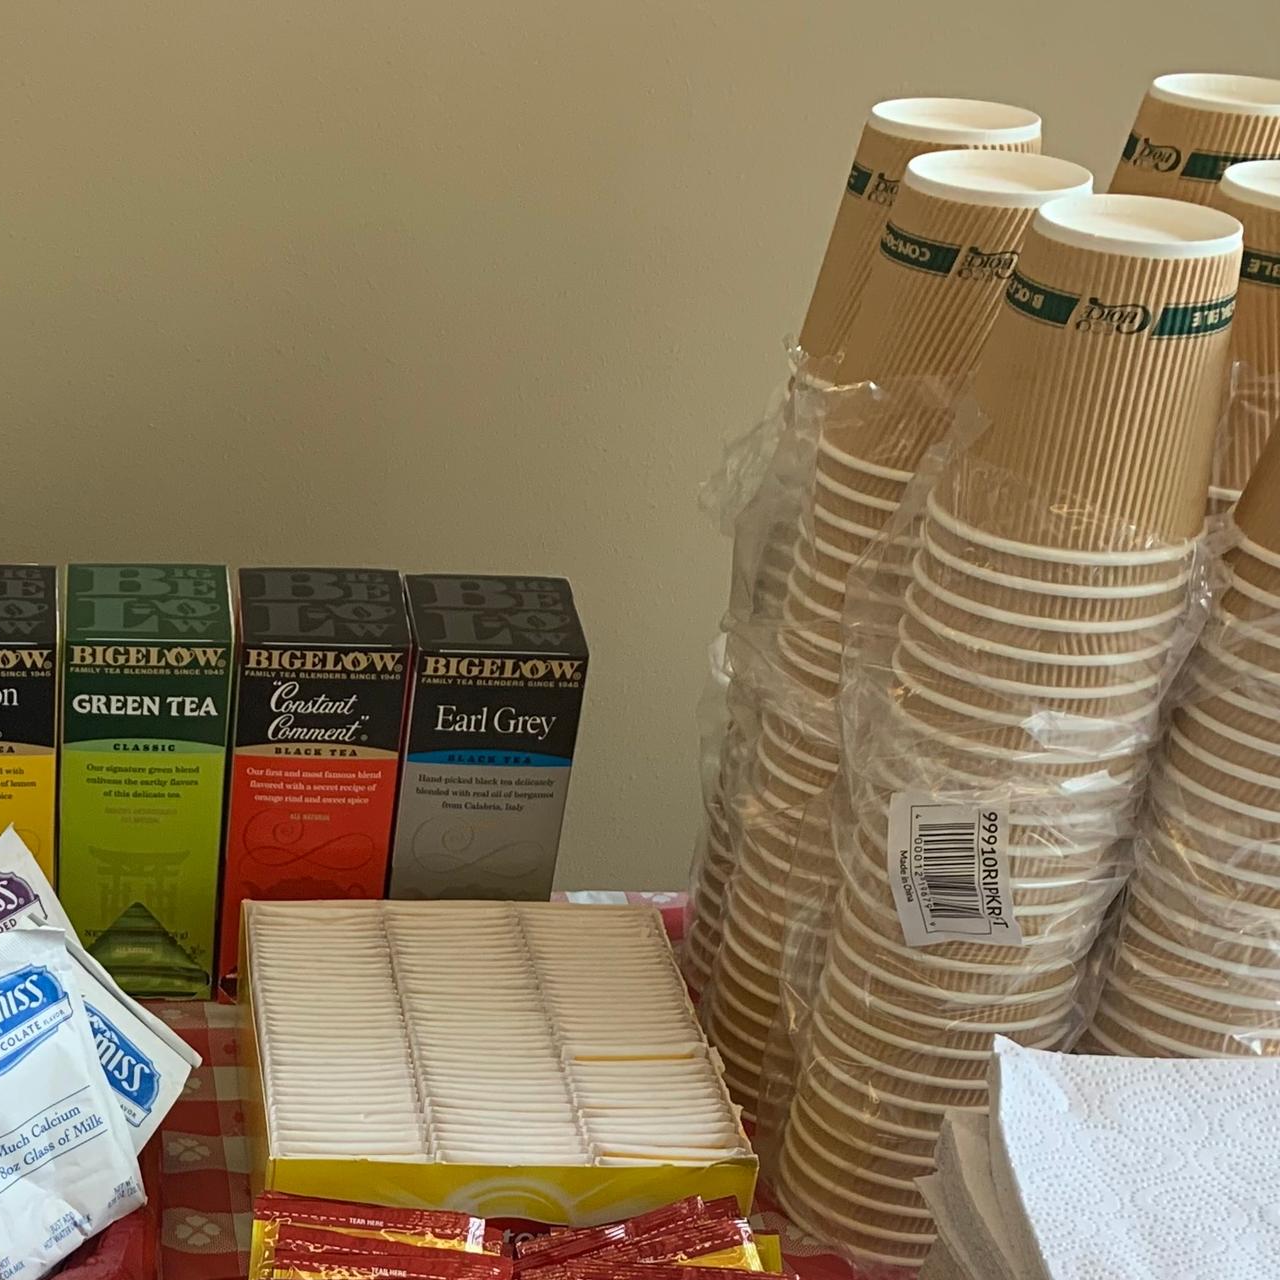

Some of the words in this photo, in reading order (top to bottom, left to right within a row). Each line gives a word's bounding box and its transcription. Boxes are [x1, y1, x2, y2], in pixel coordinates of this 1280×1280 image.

[71, 646, 226, 666] BIGELOW
[245, 650, 403, 672] BIGELOW
[422, 656, 583, 679] BIGELOW
[73, 694, 160, 715] GREEN
[167, 697, 218, 716] TEA
[434, 705, 487, 732] Earl
[494, 707, 556, 740] Grey
[113, 743, 175, 751] CLASSIC
[504, 756, 531, 764] TEA
[285, 769, 300, 777] and
[250, 780, 283, 789] flavored
[286, 781, 304, 790] with
[340, 784, 365, 792] recipe
[418, 775, 441, 784] Hand
[445, 776, 472, 785] picked
[475, 777, 497, 785] black
[515, 778, 555, 787] delicately
[285, 794, 302, 802] rind
[304, 795, 320, 803] and
[416, 788, 449, 796] blended
[473, 790, 489, 798] real
[491, 790, 501, 798] oil
[504, 790, 512, 798] of
[514, 791, 553, 799] bergamot
[505, 803, 523, 812] Italy
[900, 850, 908, 875] Made
[903, 884, 914, 902] China
[43, 1009, 65, 1026] FLAVOR
[31, 1106, 81, 1138] Calcium
[0, 1163, 20, 1179] 8oz
[24, 1144, 55, 1165] Glass
[58, 1129, 70, 1146] of
[72, 1114, 104, 1139] Milk
[349, 1217, 365, 1225] TEAR
[13, 1261, 26, 1274] MIX
[371, 1268, 388, 1276] TEAR
[389, 1269, 407, 1278] HERE
